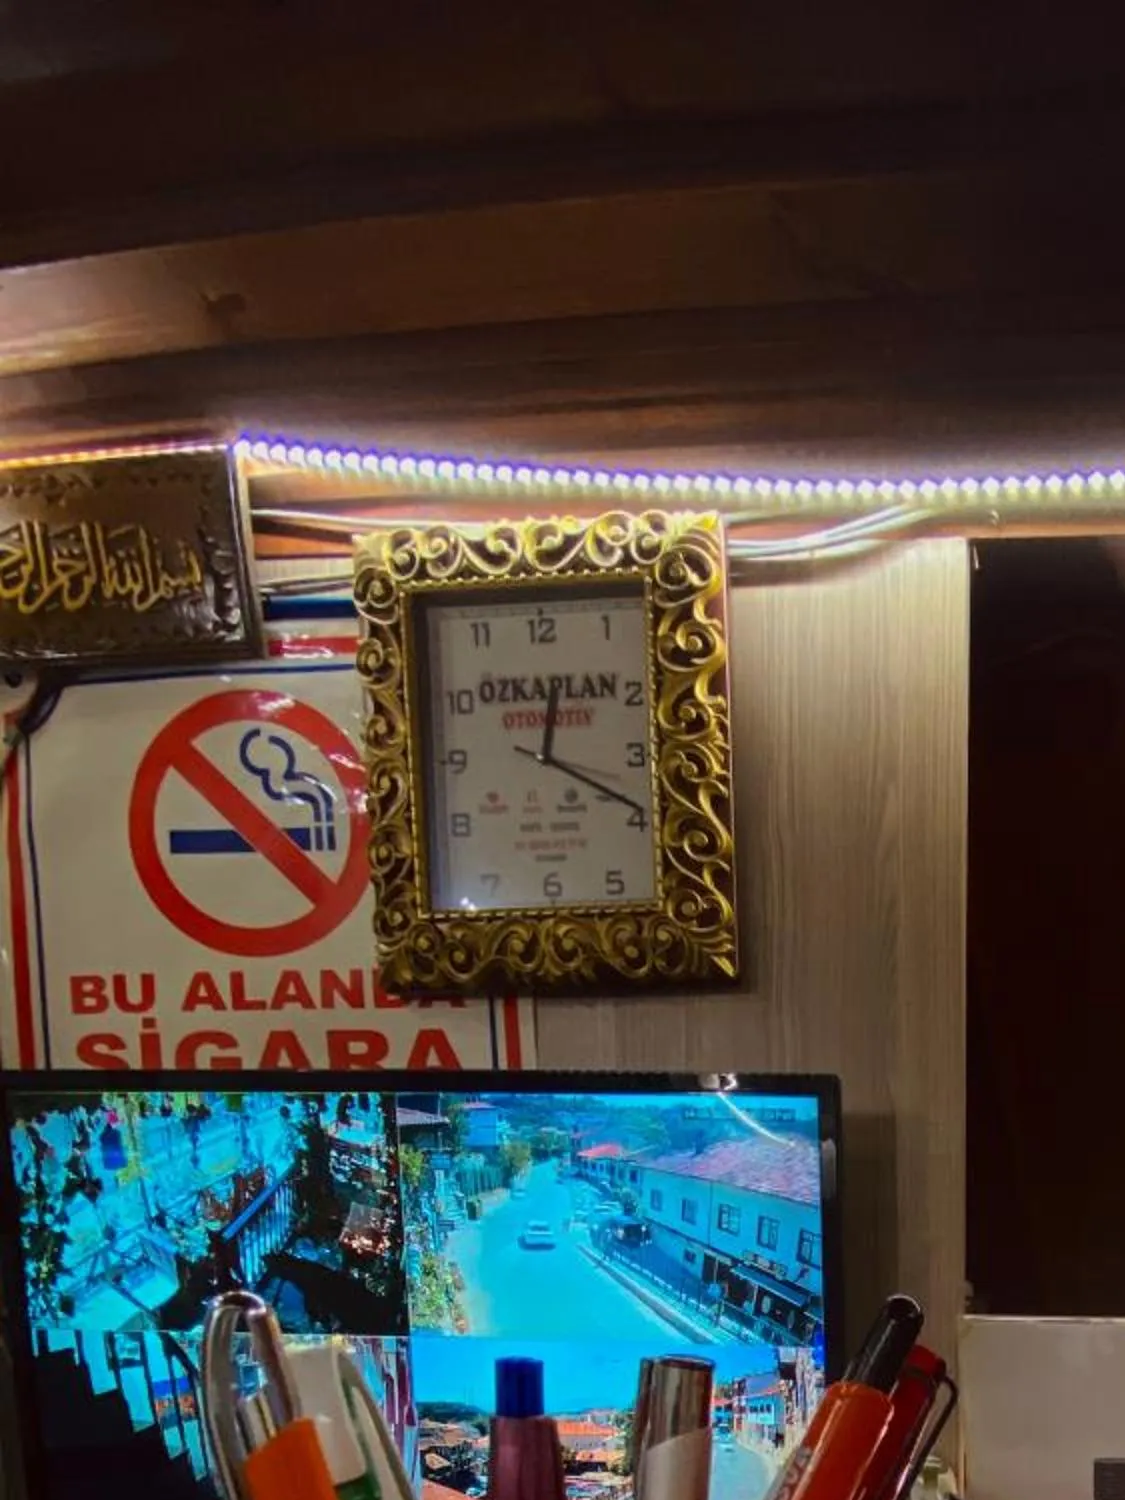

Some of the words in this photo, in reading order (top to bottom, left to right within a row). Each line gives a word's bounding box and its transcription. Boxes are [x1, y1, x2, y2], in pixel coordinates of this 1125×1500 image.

[470, 621, 491, 648] 11
[527, 616, 557, 644] 12
[601, 614, 612, 641] 1
[448, 689, 475, 716] 10
[624, 680, 645, 707] 2
[448, 750, 468, 775] 9
[625, 742, 646, 768] 3
[451, 812, 472, 838] 8
[626, 808, 649, 833] 4
[480, 873, 501, 899] 7
[543, 872, 563, 898] 6
[605, 870, 626, 896] 5
[69, 972, 156, 1015] BU
[181, 966, 468, 1012] ALAN
[75, 1017, 465, 1071] SİGARA
